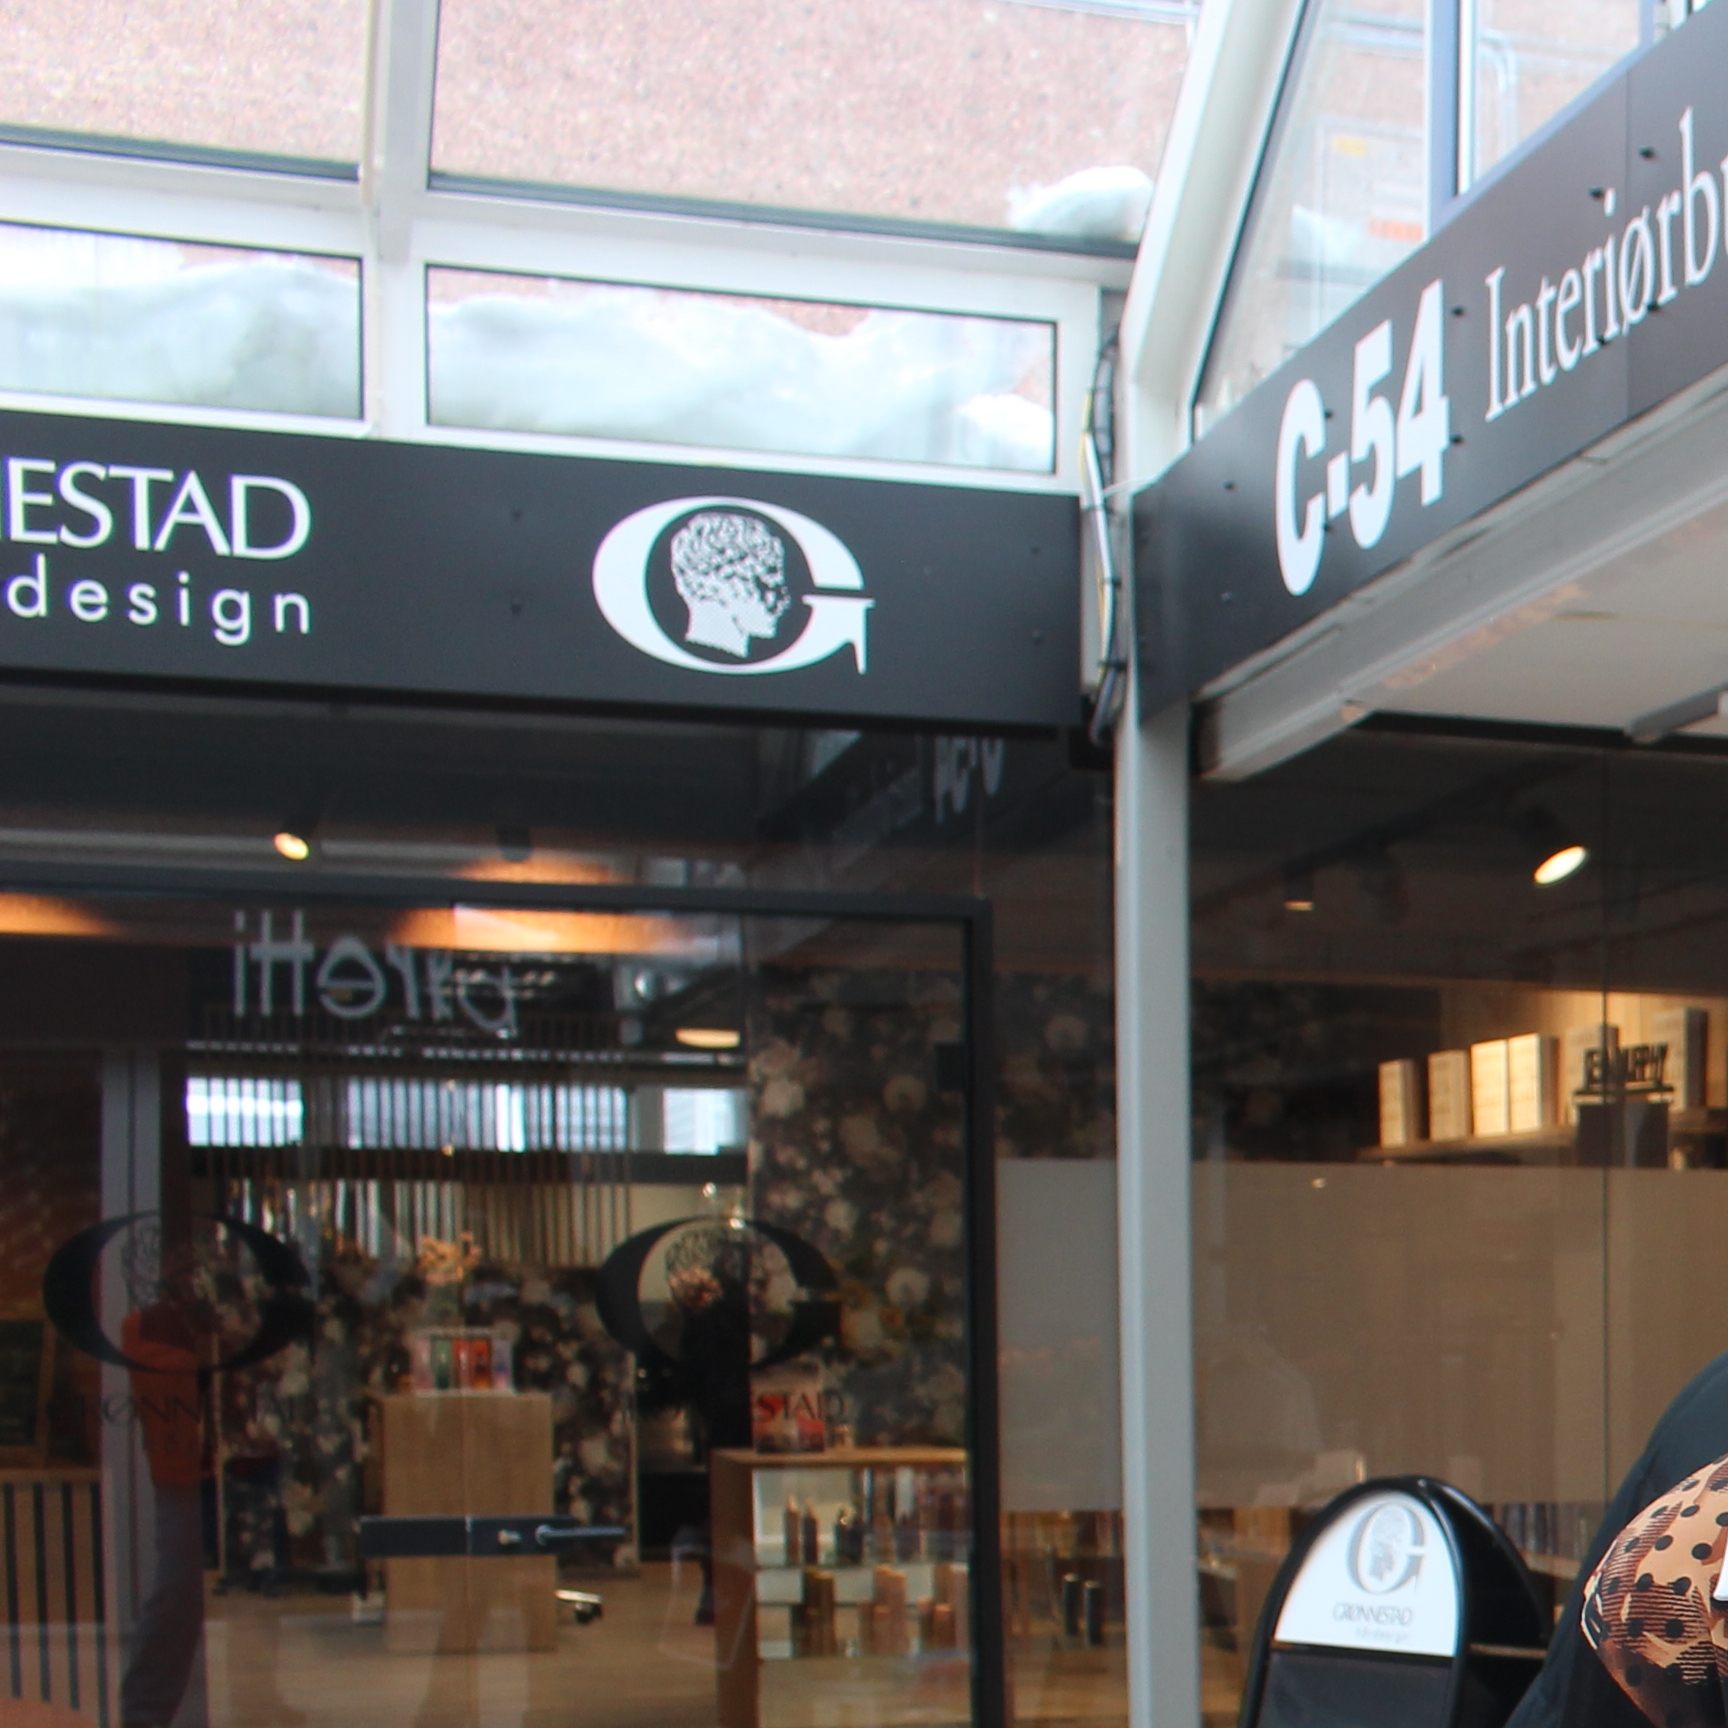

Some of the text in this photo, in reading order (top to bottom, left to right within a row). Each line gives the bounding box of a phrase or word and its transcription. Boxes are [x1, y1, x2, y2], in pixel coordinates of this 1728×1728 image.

[1275, 279, 1450, 597] C-54
[5, 456, 312, 560] ESTAD
[5, 553, 312, 646] design
